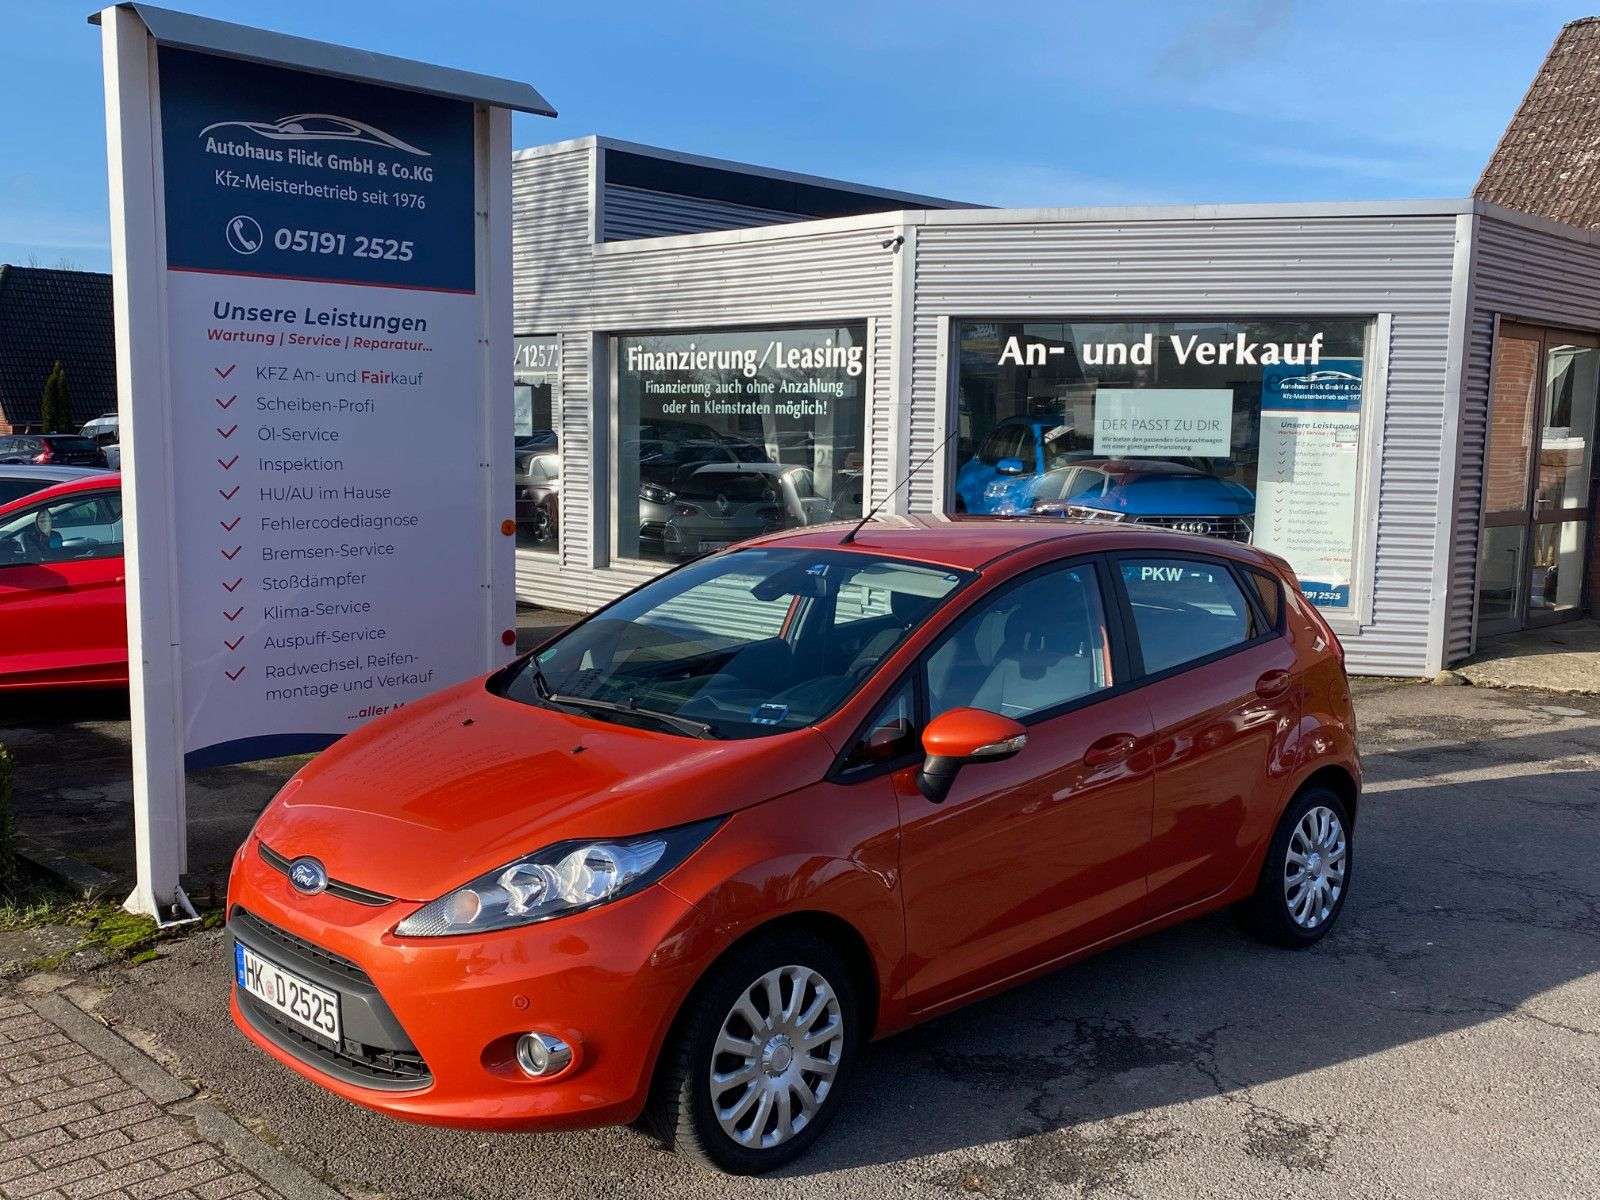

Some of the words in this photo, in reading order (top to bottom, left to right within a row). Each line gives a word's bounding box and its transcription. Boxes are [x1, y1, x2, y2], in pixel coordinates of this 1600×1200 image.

[205, 137, 283, 162] Autohaus
[288, 149, 323, 168] Flick
[328, 154, 373, 175] GmbH
[378, 162, 388, 176] &
[392, 163, 433, 182] Co.KG
[215, 170, 357, 201] Kfz-Meisterbetrieb
[362, 189, 389, 205] seit
[393, 192, 426, 210] 1976
[274, 228, 346, 255] 05191
[353, 236, 414, 262] 2525
[213, 301, 297, 323] Unsere
[304, 307, 427, 334] Leistungen
[207, 329, 275, 346] Wartung
[288, 333, 341, 348] Service
[353, 337, 433, 352] Reparatur...
[998, 336, 1064, 366] An-
[1083, 333, 1152, 365] und
[1170, 332, 1324, 366] Verkauf
[256, 366, 288, 381] KFZ
[293, 367, 321, 382] An-
[325, 369, 356, 383] und
[361, 370, 423, 386] Fairkauf
[645, 380, 711, 397] Finanzierung
[715, 381, 742, 394] auch
[747, 381, 775, 394] ohne
[779, 379, 844, 397] Anzahlung
[256, 397, 375, 413] Scheiben-Profi
[662, 401, 686, 414] oder
[690, 400, 700, 414] in
[704, 400, 770, 415] Kleinstraten
[775, 399, 827, 419] möglich!
[258, 424, 339, 441] Öl-Service
[1102, 419, 1127, 431] DER
[1132, 419, 1168, 431] PASST
[1174, 419, 1193, 431] ZU
[259, 456, 344, 474] Inspektion
[260, 487, 313, 501] HU/AU
[319, 486, 339, 499] im
[344, 487, 392, 500] Hause
[261, 514, 418, 531] Fehlercodediagnose
[263, 543, 395, 561] Bremsen-Service
[1141, 566, 1184, 582] PKW
[264, 601, 371, 620] Klima-Service
[264, 628, 386, 650] Auspuff-Service
[265, 657, 361, 679] Radwechsel,
[368, 652, 419, 669] Reifen-
[266, 681, 339, 701] montage
[343, 675, 373, 692] und
[377, 670, 434, 689] Verkauf
[246, 954, 266, 997] HK
[275, 972, 287, 1008] D
[289, 981, 336, 1034] 2525
